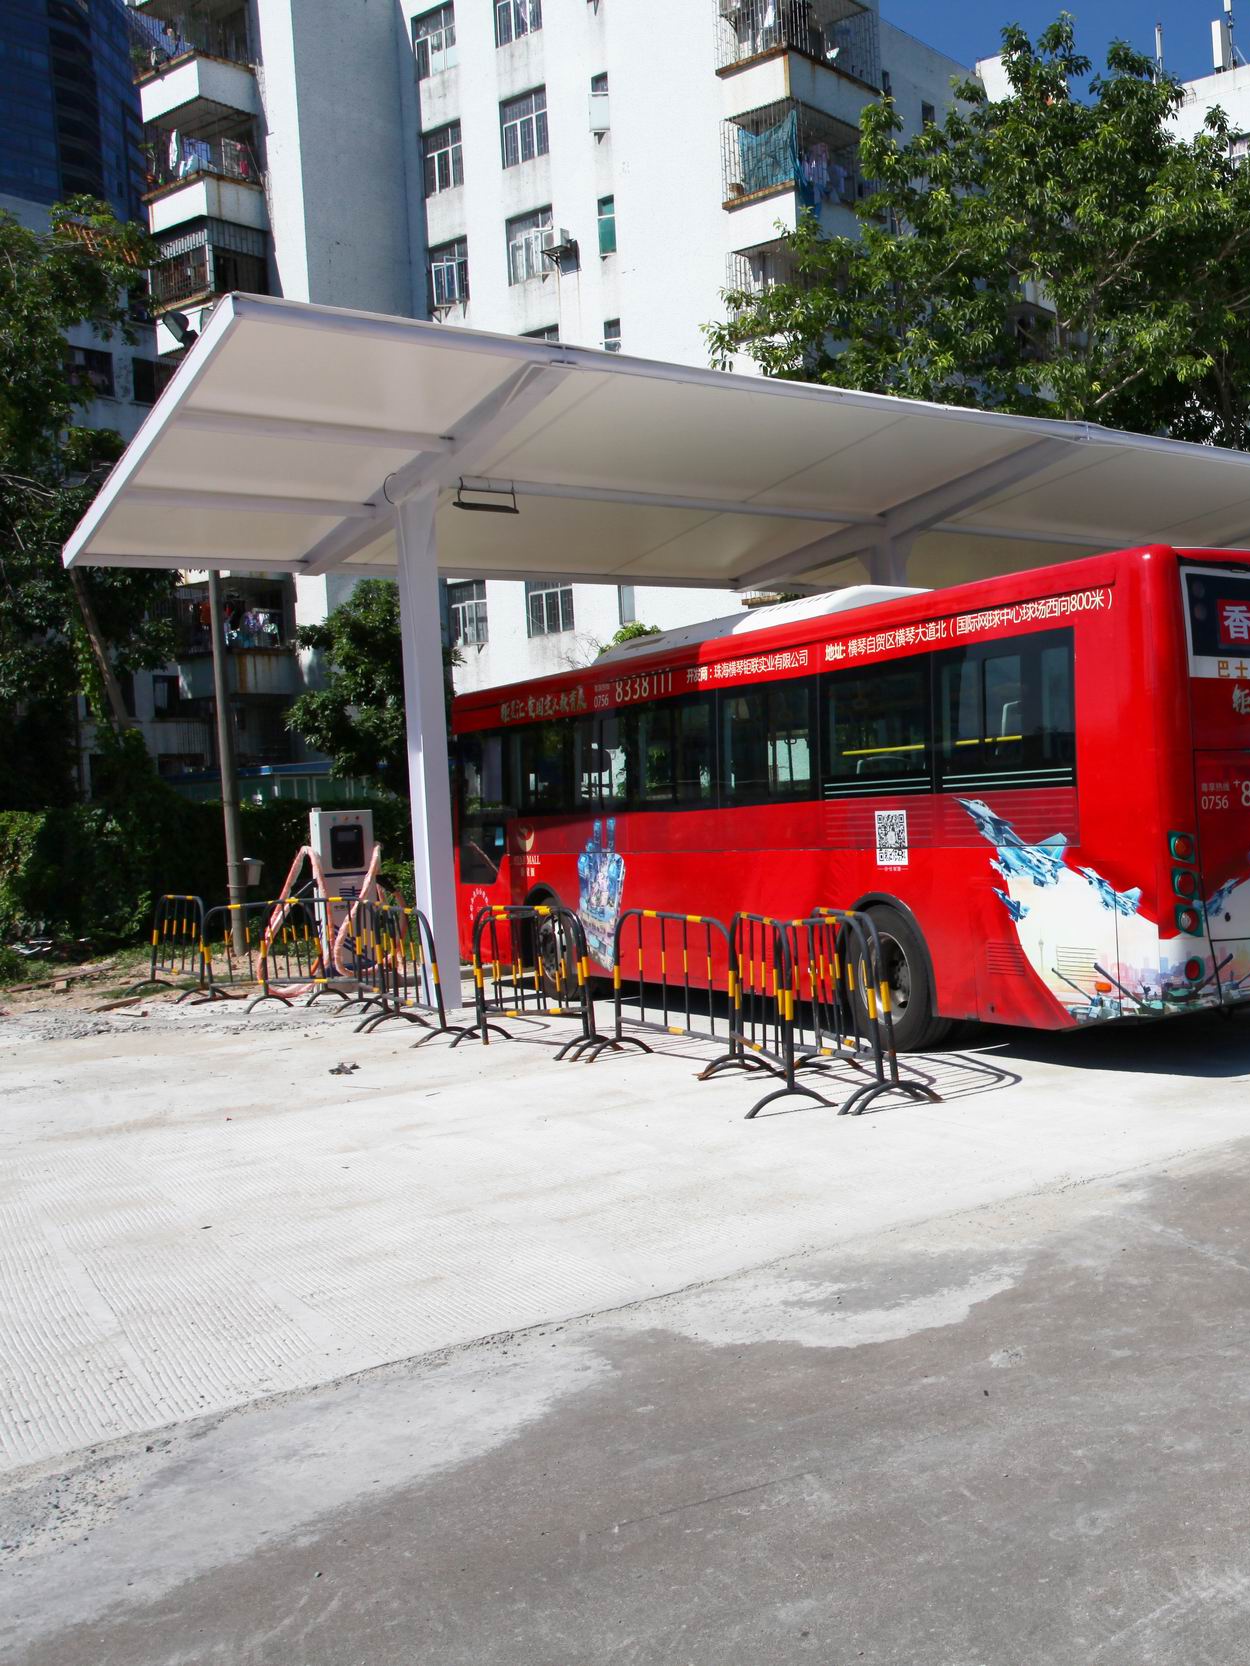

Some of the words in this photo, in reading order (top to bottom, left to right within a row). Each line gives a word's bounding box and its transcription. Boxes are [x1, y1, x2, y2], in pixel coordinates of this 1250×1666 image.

[615, 667, 672, 703] 8338111
[593, 694, 609, 708] 0756
[1201, 795, 1229, 810] 0756
[526, 855, 541, 865] MALL
